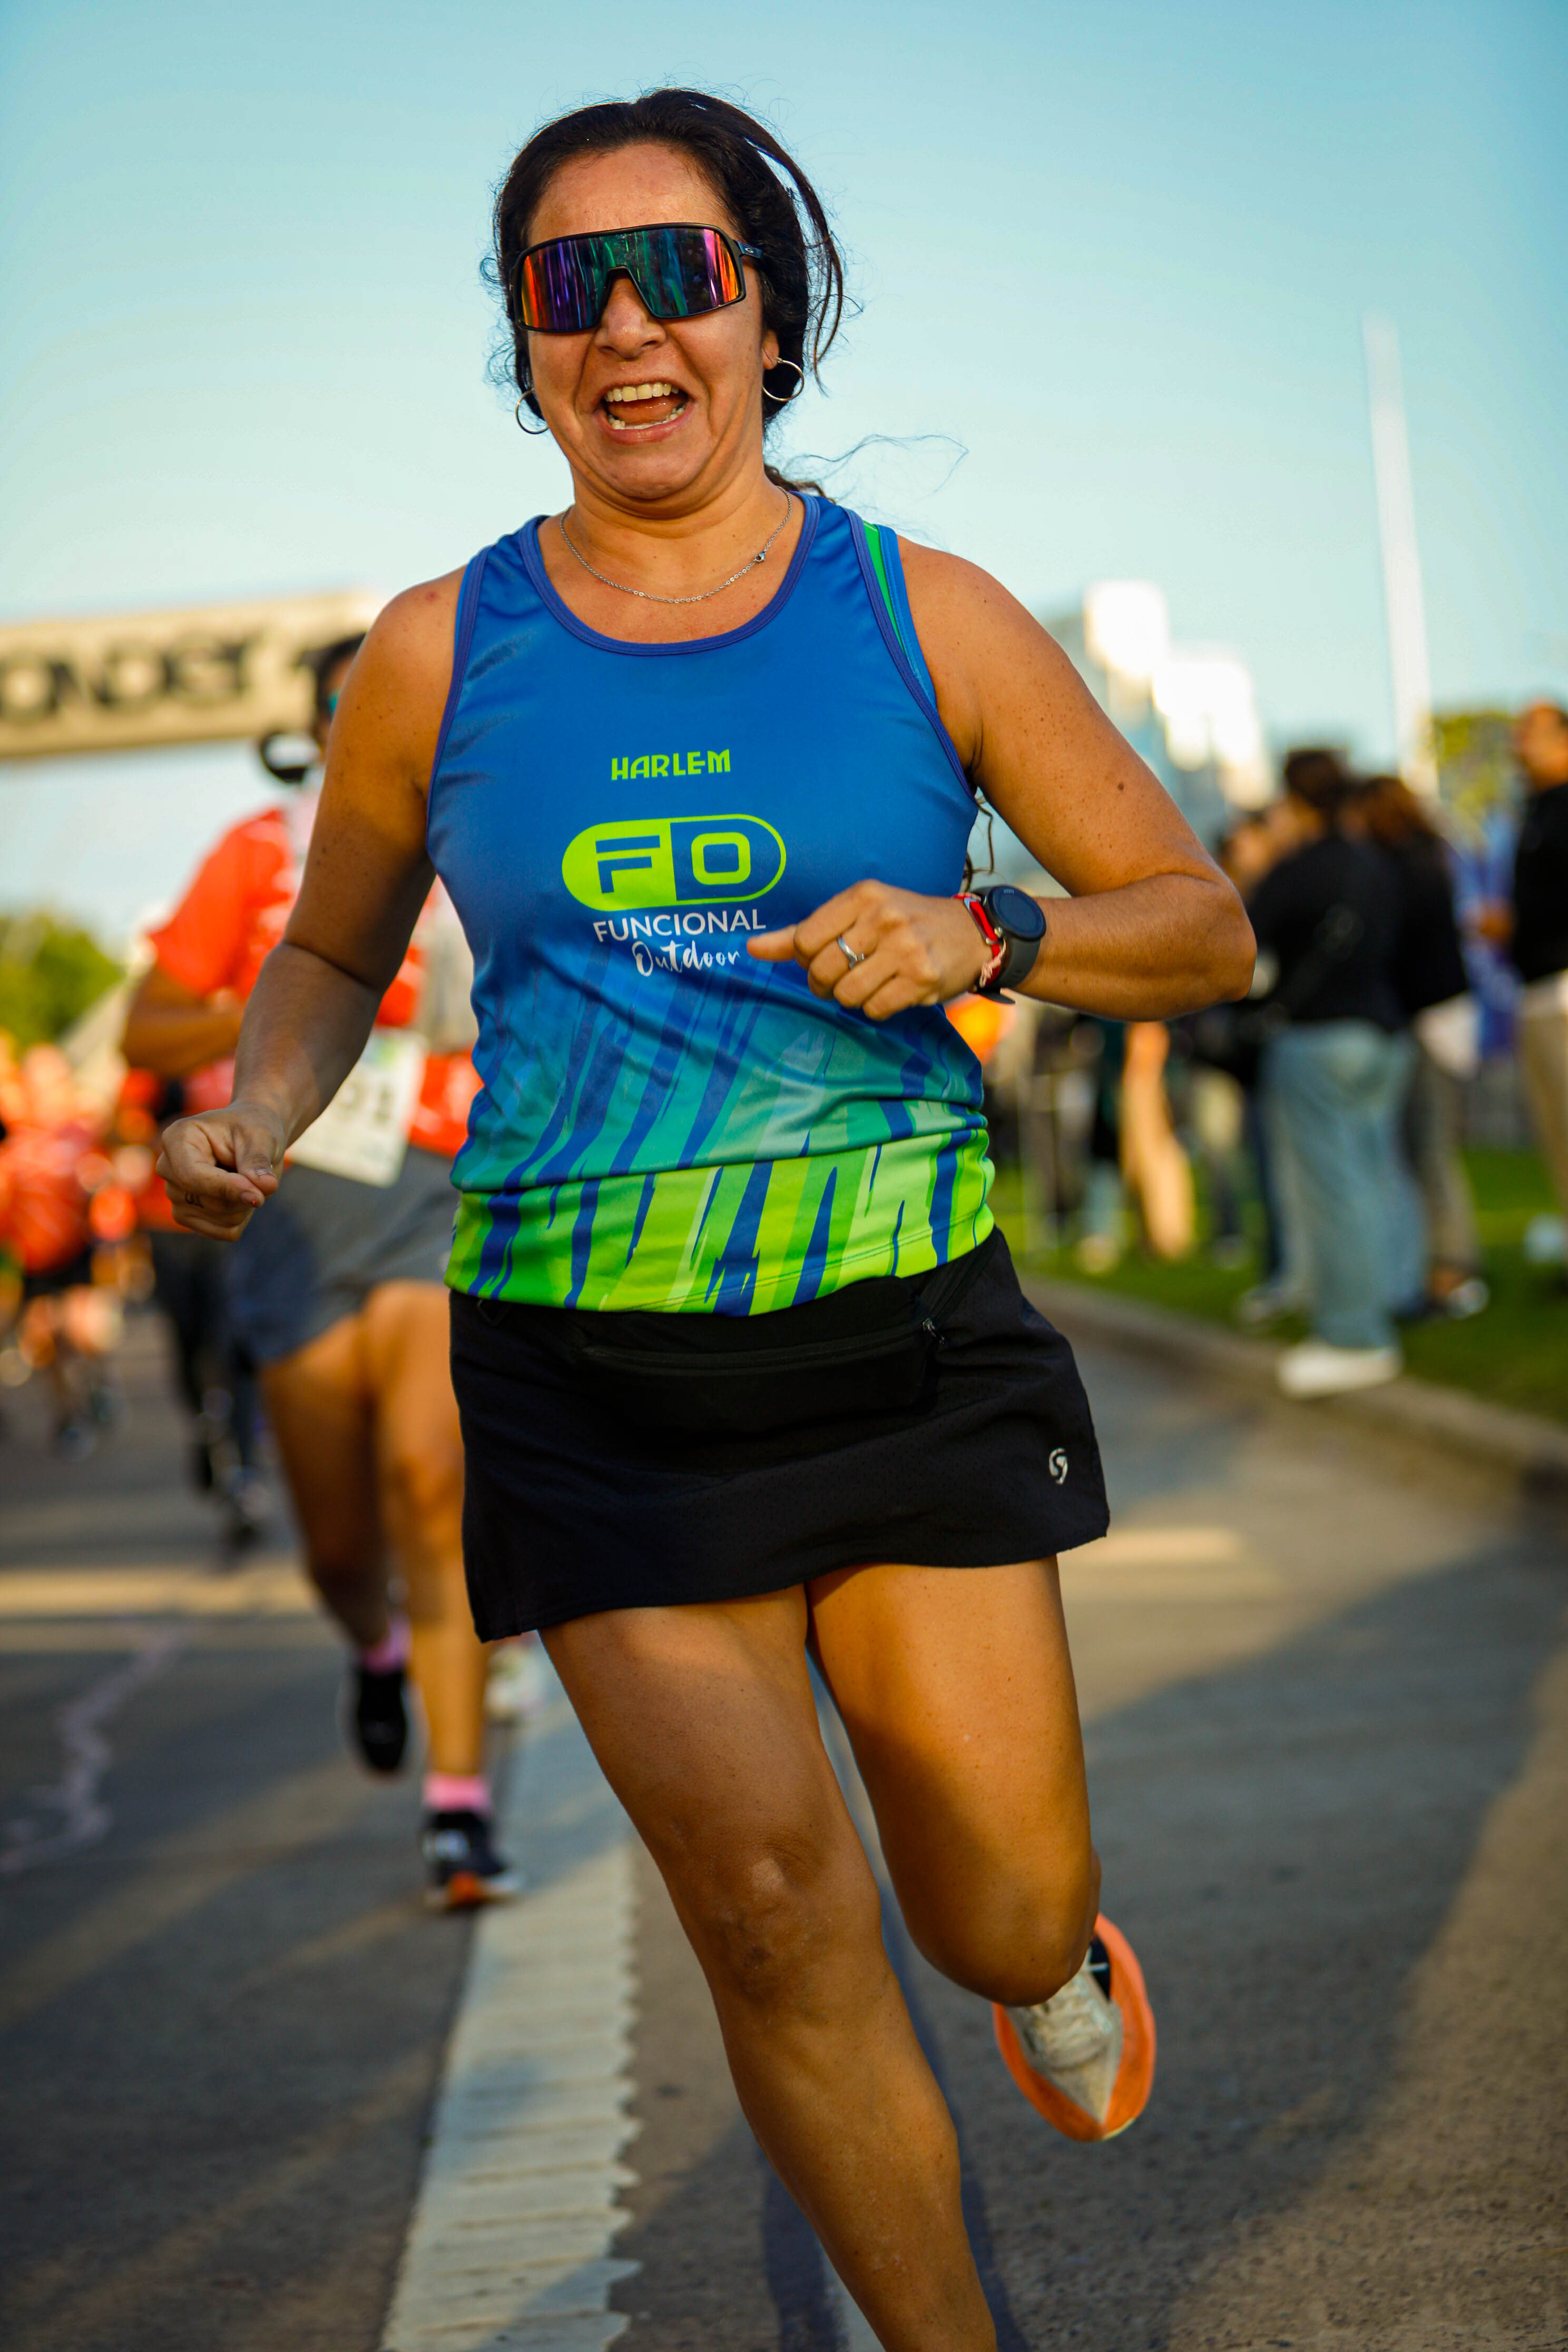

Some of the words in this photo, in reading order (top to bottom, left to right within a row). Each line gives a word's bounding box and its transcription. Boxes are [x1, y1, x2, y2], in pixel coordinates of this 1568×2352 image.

[611, 749, 731, 780] HARLEM
[594, 831, 752, 894] FO
[593, 909, 766, 942] FUNCIONAL
[632, 940, 741, 977] Outdoor
